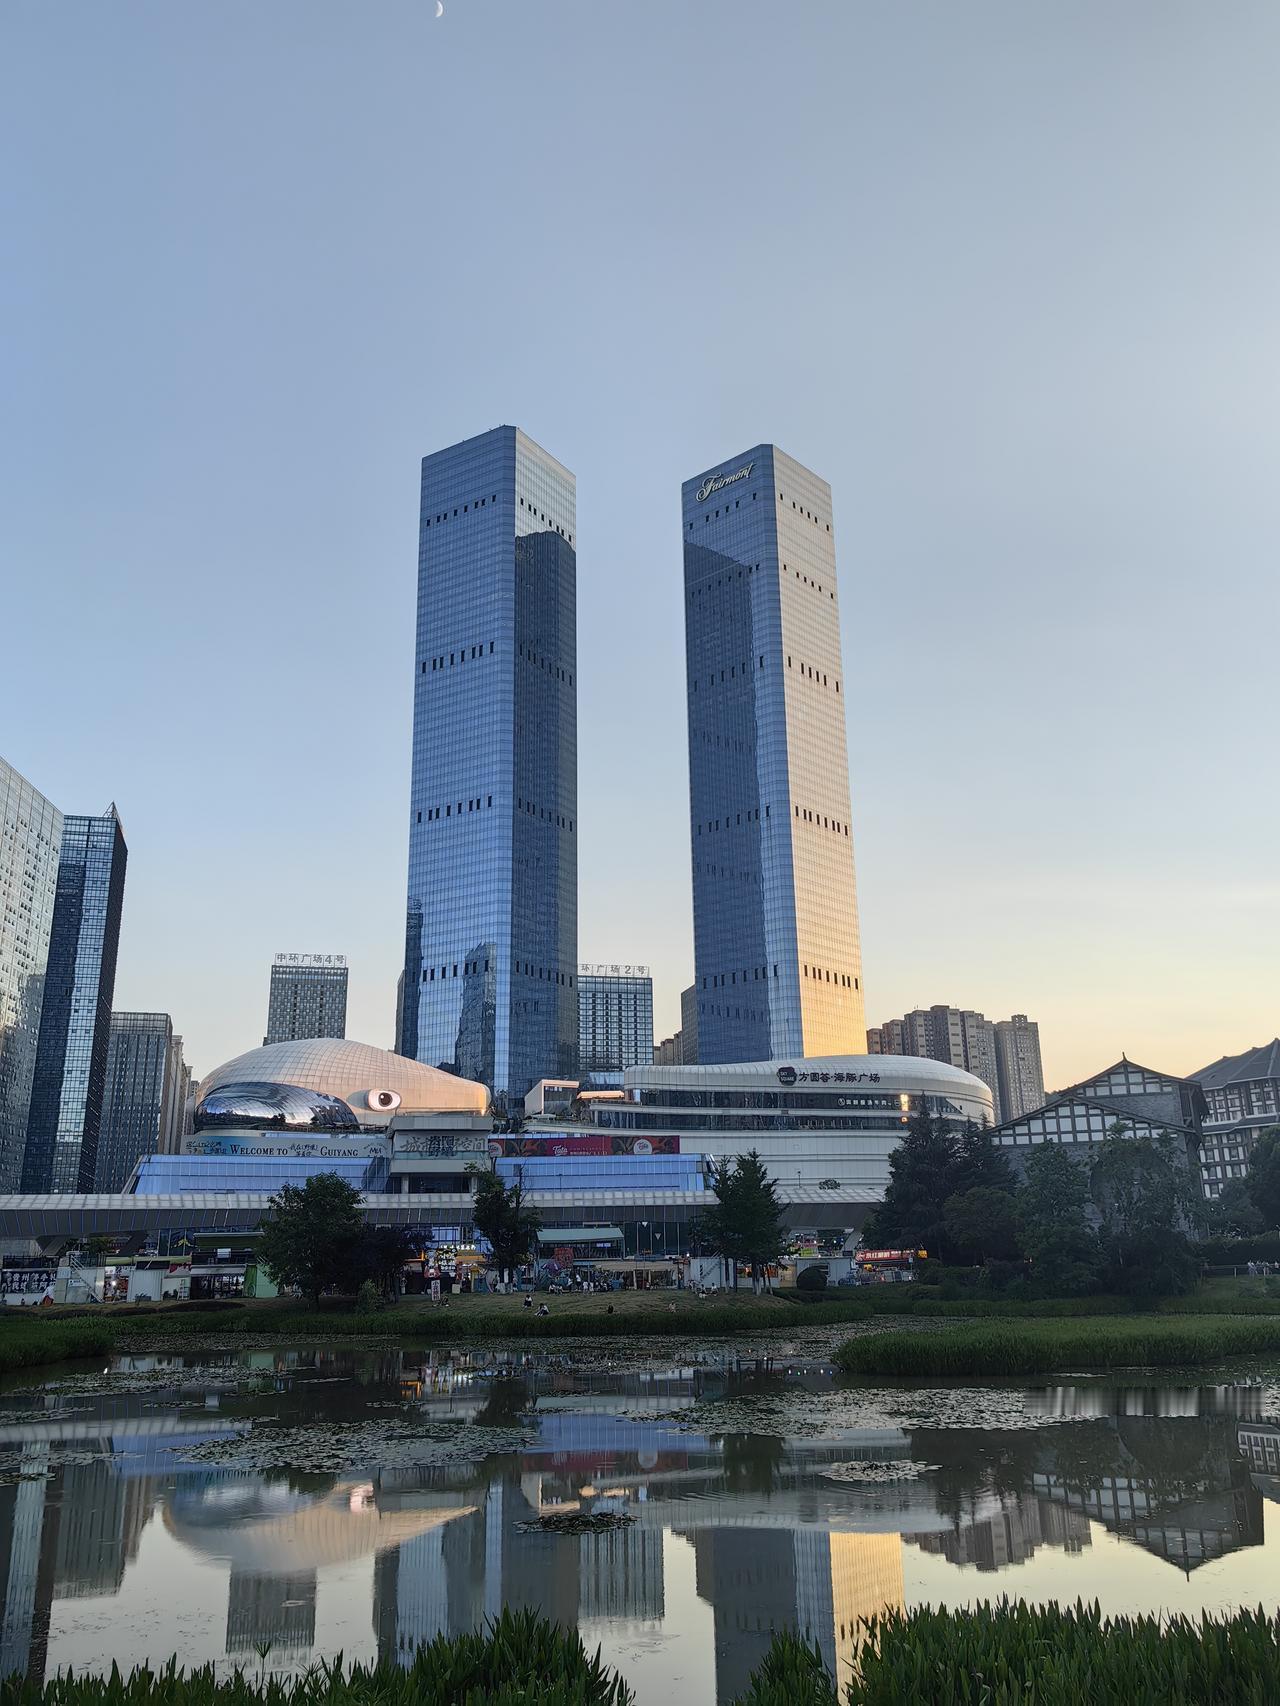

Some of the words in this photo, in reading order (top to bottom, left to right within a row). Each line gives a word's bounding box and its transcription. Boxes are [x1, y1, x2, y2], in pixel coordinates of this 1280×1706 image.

[696, 462, 756, 502] Fairmont
[277, 953, 344, 964] 中环广场4号
[230, 1144, 274, 1155] WELCOME
[277, 1148, 288, 1156] TO
[320, 1146, 358, 1157] GUIYANG
